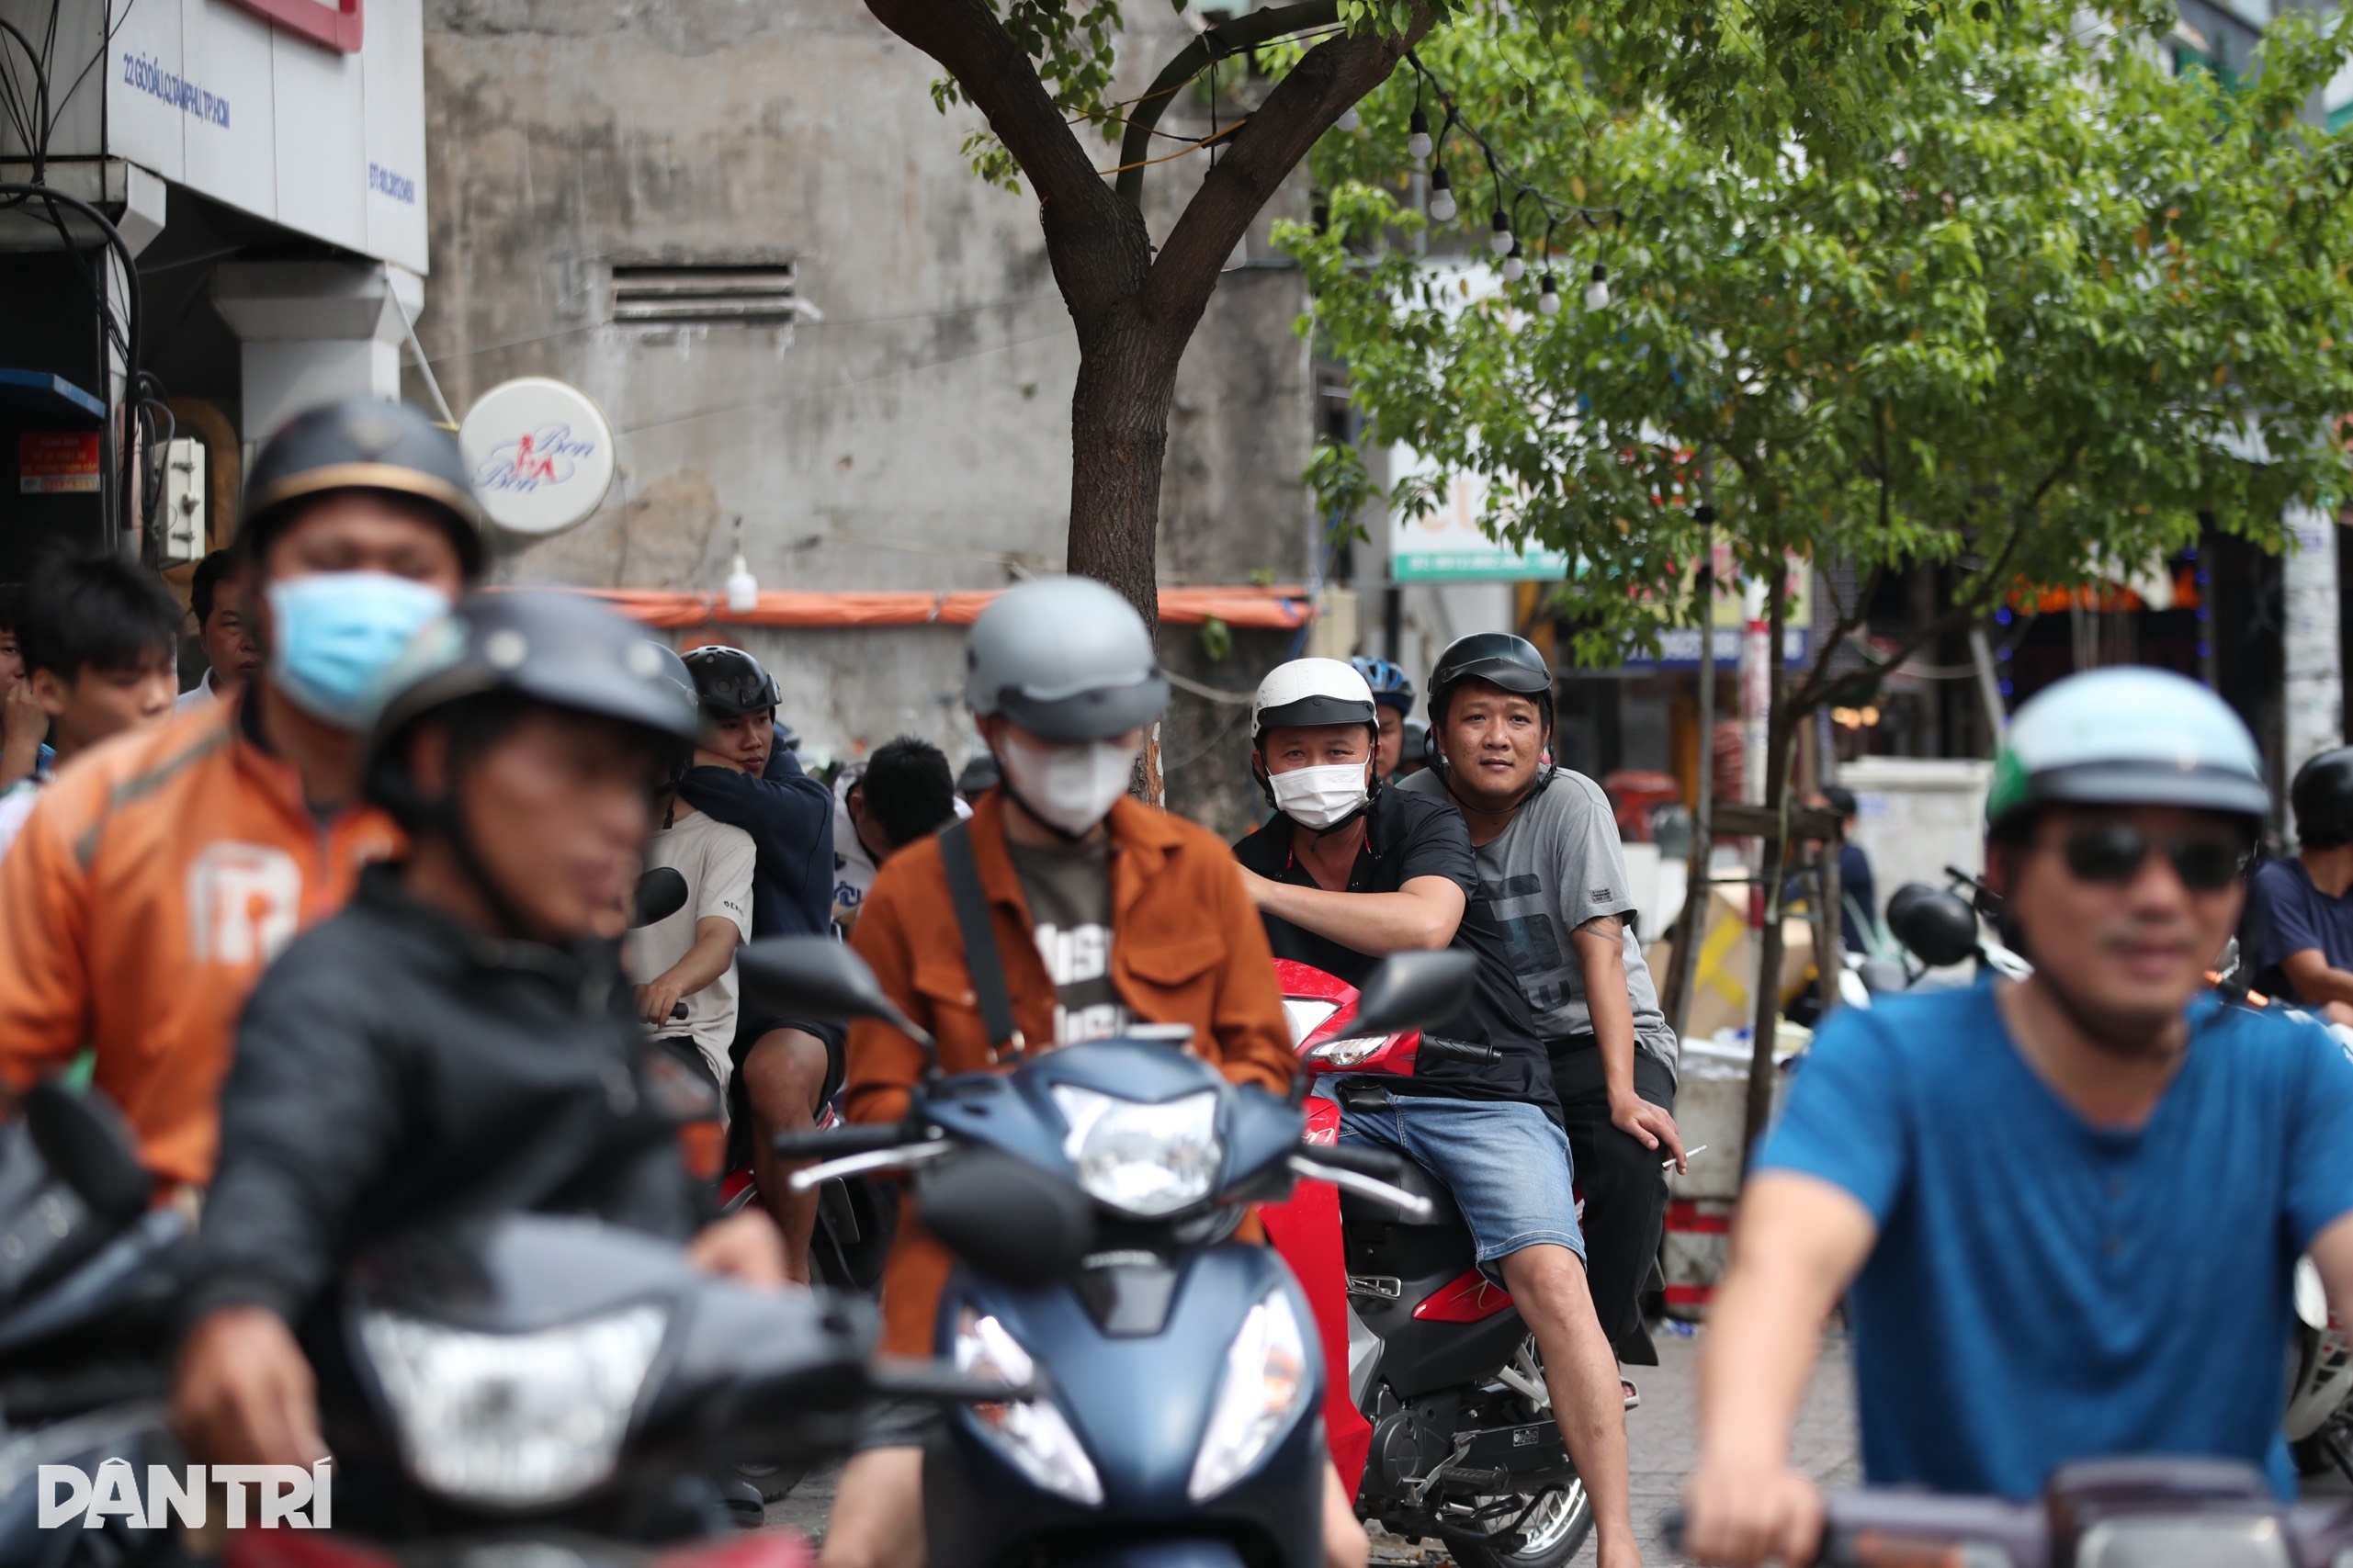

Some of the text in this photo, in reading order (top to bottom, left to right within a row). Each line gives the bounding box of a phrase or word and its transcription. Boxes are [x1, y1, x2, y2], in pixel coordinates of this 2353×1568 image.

[123, 52, 134, 86] 22
[533, 423, 595, 457] Bon
[478, 460, 540, 491] Bon
